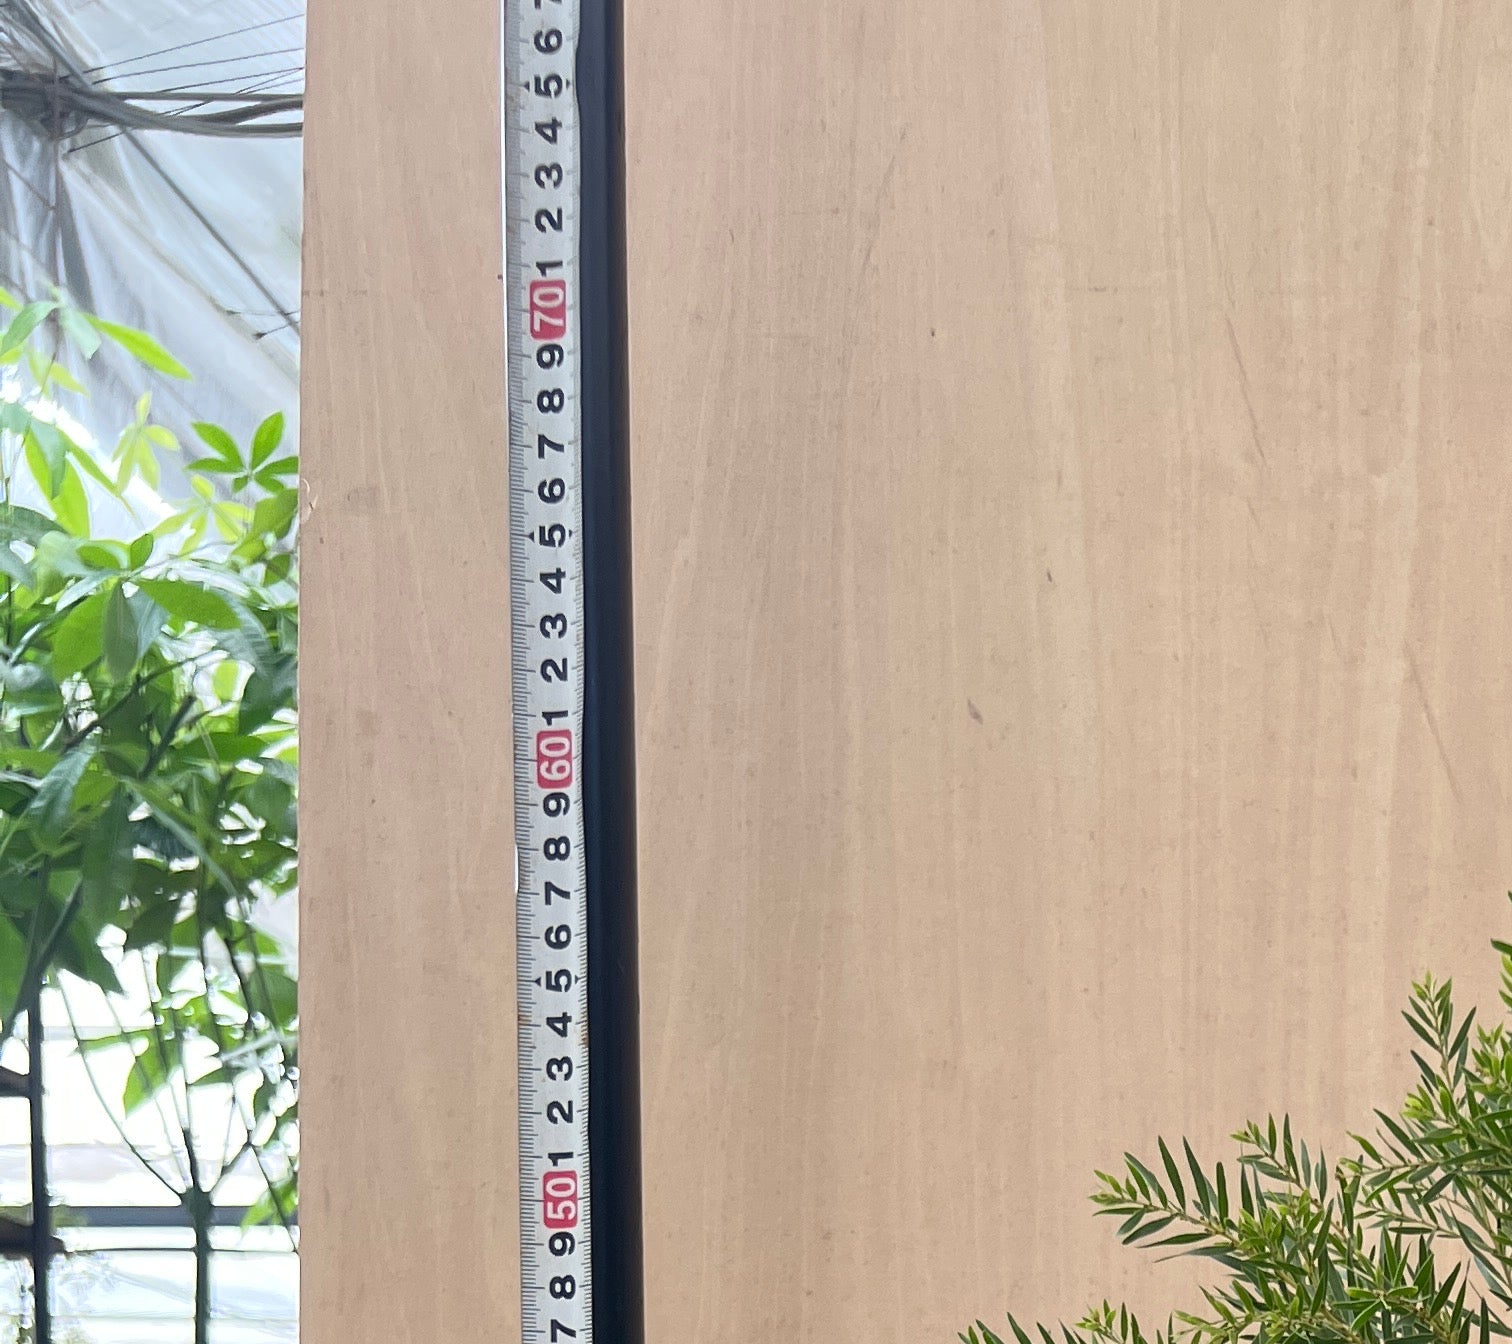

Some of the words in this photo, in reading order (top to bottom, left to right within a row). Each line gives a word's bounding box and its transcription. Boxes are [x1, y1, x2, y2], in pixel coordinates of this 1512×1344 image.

[533, 28, 563, 54] 6
[534, 73, 563, 98] 5
[534, 118, 562, 144] 4
[534, 163, 563, 189] 3
[534, 208, 563, 234] 2
[535, 260, 563, 277] 1
[533, 287, 564, 332] 70
[536, 343, 564, 370] 9
[536, 388, 565, 414] 8
[537, 433, 565, 459] 7
[537, 478, 566, 504] 6
[538, 523, 566, 548] 5
[539, 567, 566, 594] 4
[539, 613, 568, 639] 3
[540, 657, 568, 683] 2
[541, 710, 569, 726] 1
[540, 736, 570, 780] 60
[542, 791, 570, 818] 9
[543, 835, 571, 861] 8
[544, 881, 571, 906] 7
[544, 924, 572, 950] 6
[545, 968, 572, 993] 5
[546, 1011, 572, 1038] 4
[545, 1056, 573, 1081] 3
[546, 1100, 574, 1125] 2
[547, 1151, 574, 1167] 1
[546, 1177, 576, 1220] 50
[548, 1231, 576, 1257] 9
[549, 1274, 576, 1300] 8
[550, 1319, 577, 1343] 7
